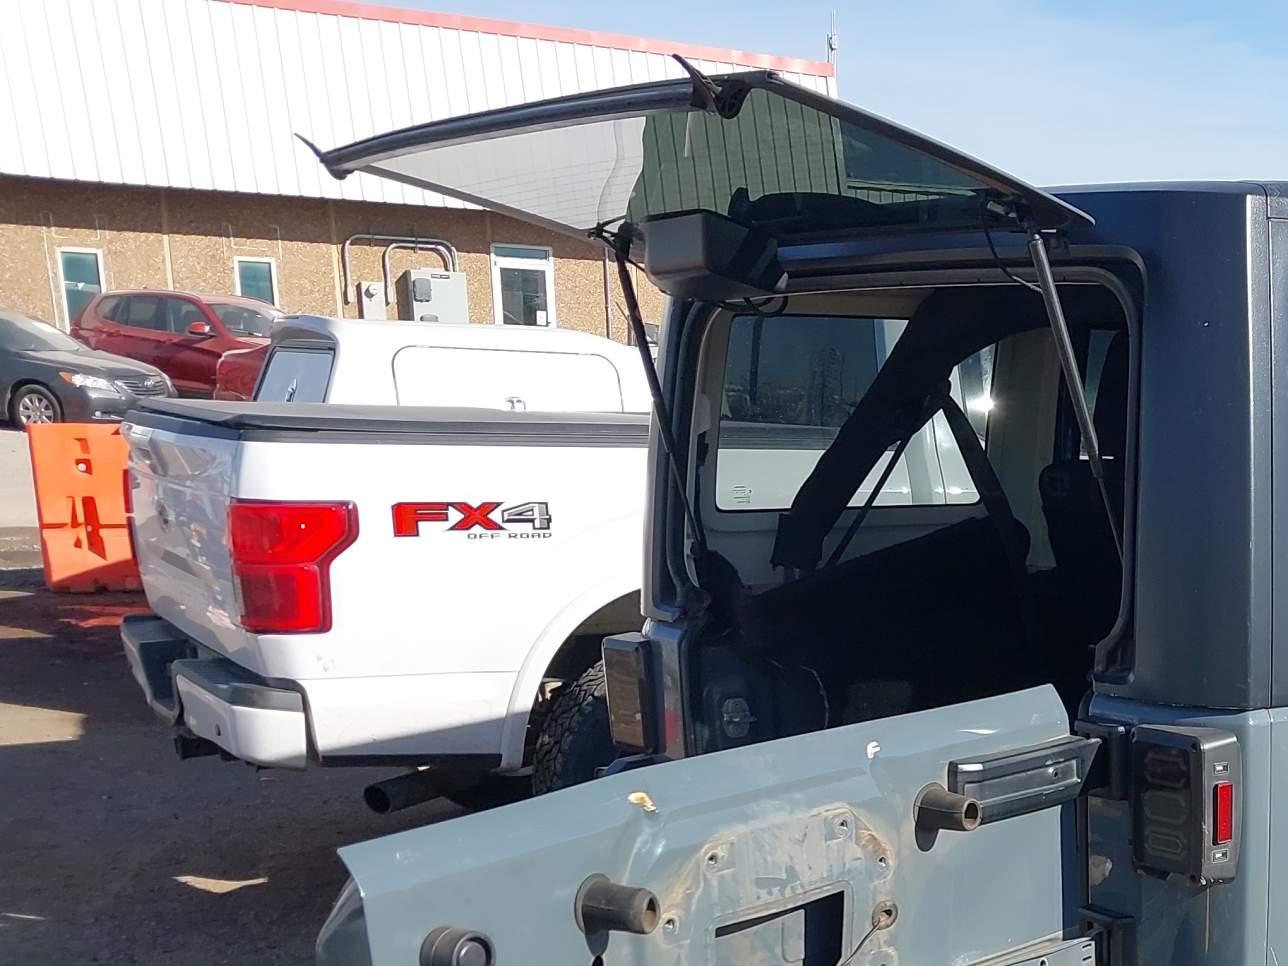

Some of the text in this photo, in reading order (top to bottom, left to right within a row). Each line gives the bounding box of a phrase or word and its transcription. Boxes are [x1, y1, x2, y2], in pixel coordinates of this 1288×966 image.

[391, 501, 552, 537] FX4
[467, 532, 552, 540] OFF ROAD
